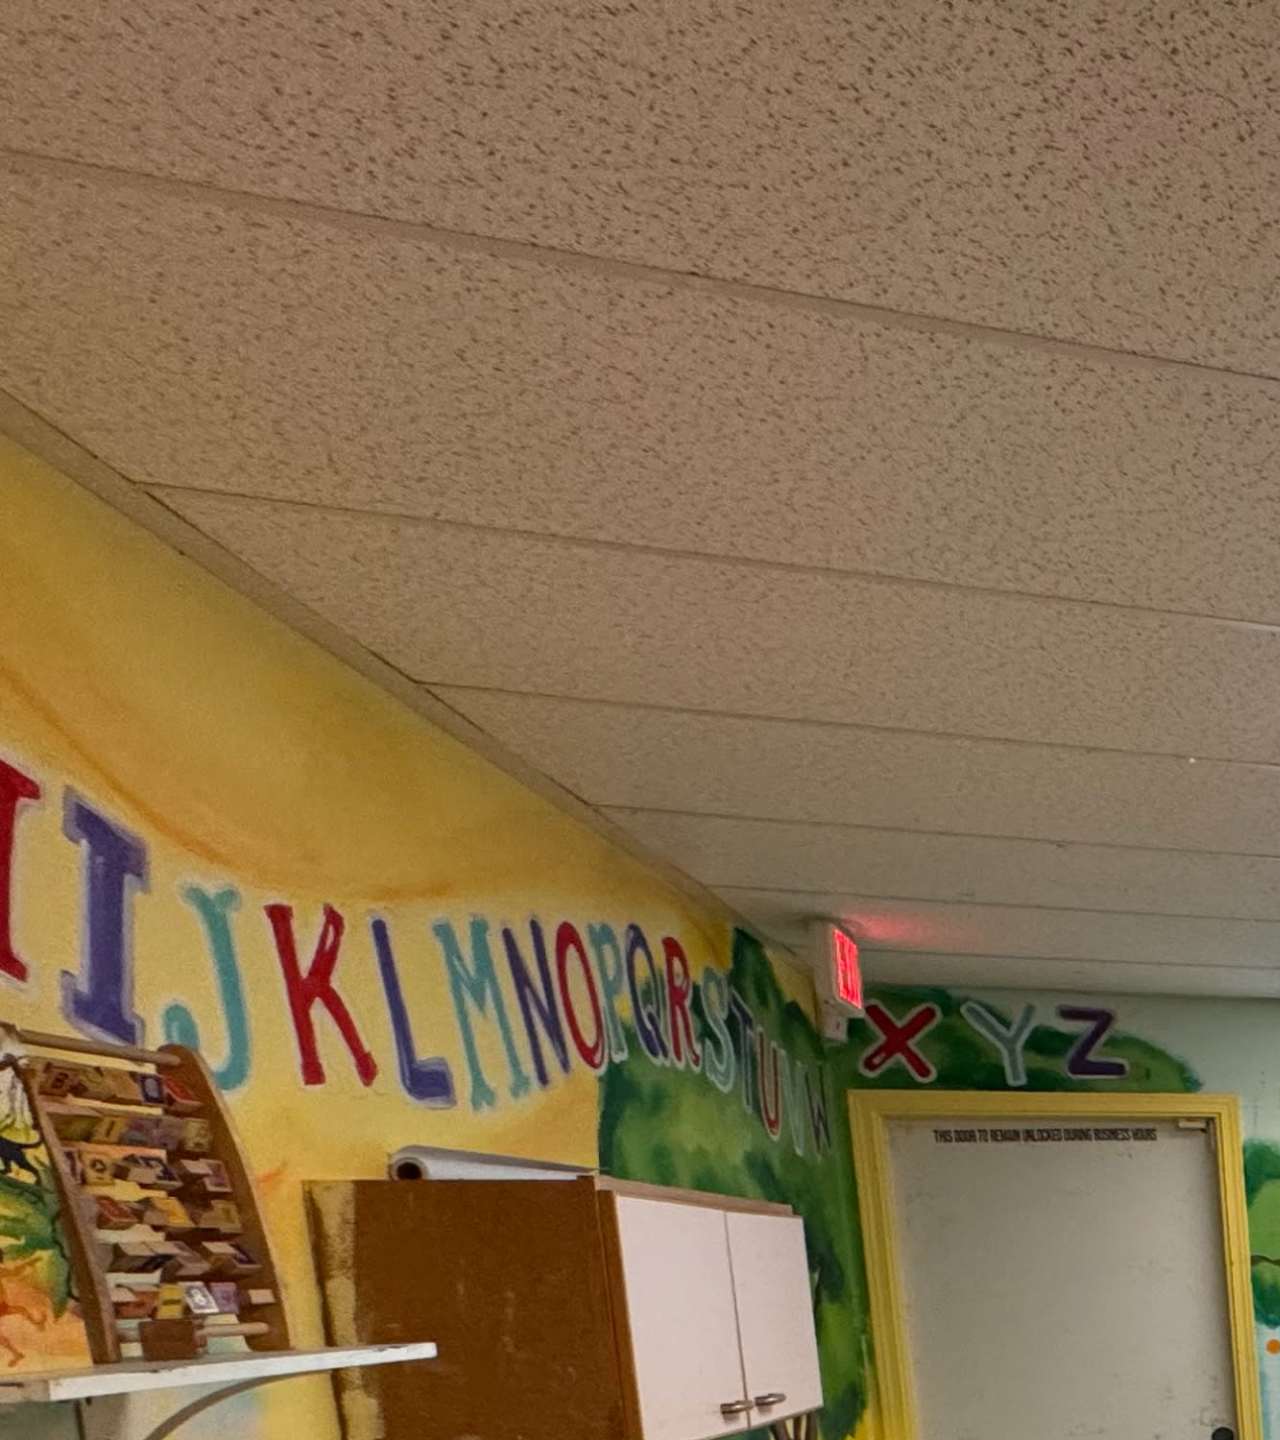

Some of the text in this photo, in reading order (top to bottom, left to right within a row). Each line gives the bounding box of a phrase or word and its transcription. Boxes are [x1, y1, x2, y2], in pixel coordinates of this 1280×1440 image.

[933, 1129, 952, 1143] THIS
[954, 1129, 977, 1143] DOOR
[1132, 1128, 1158, 1141] HOURS
